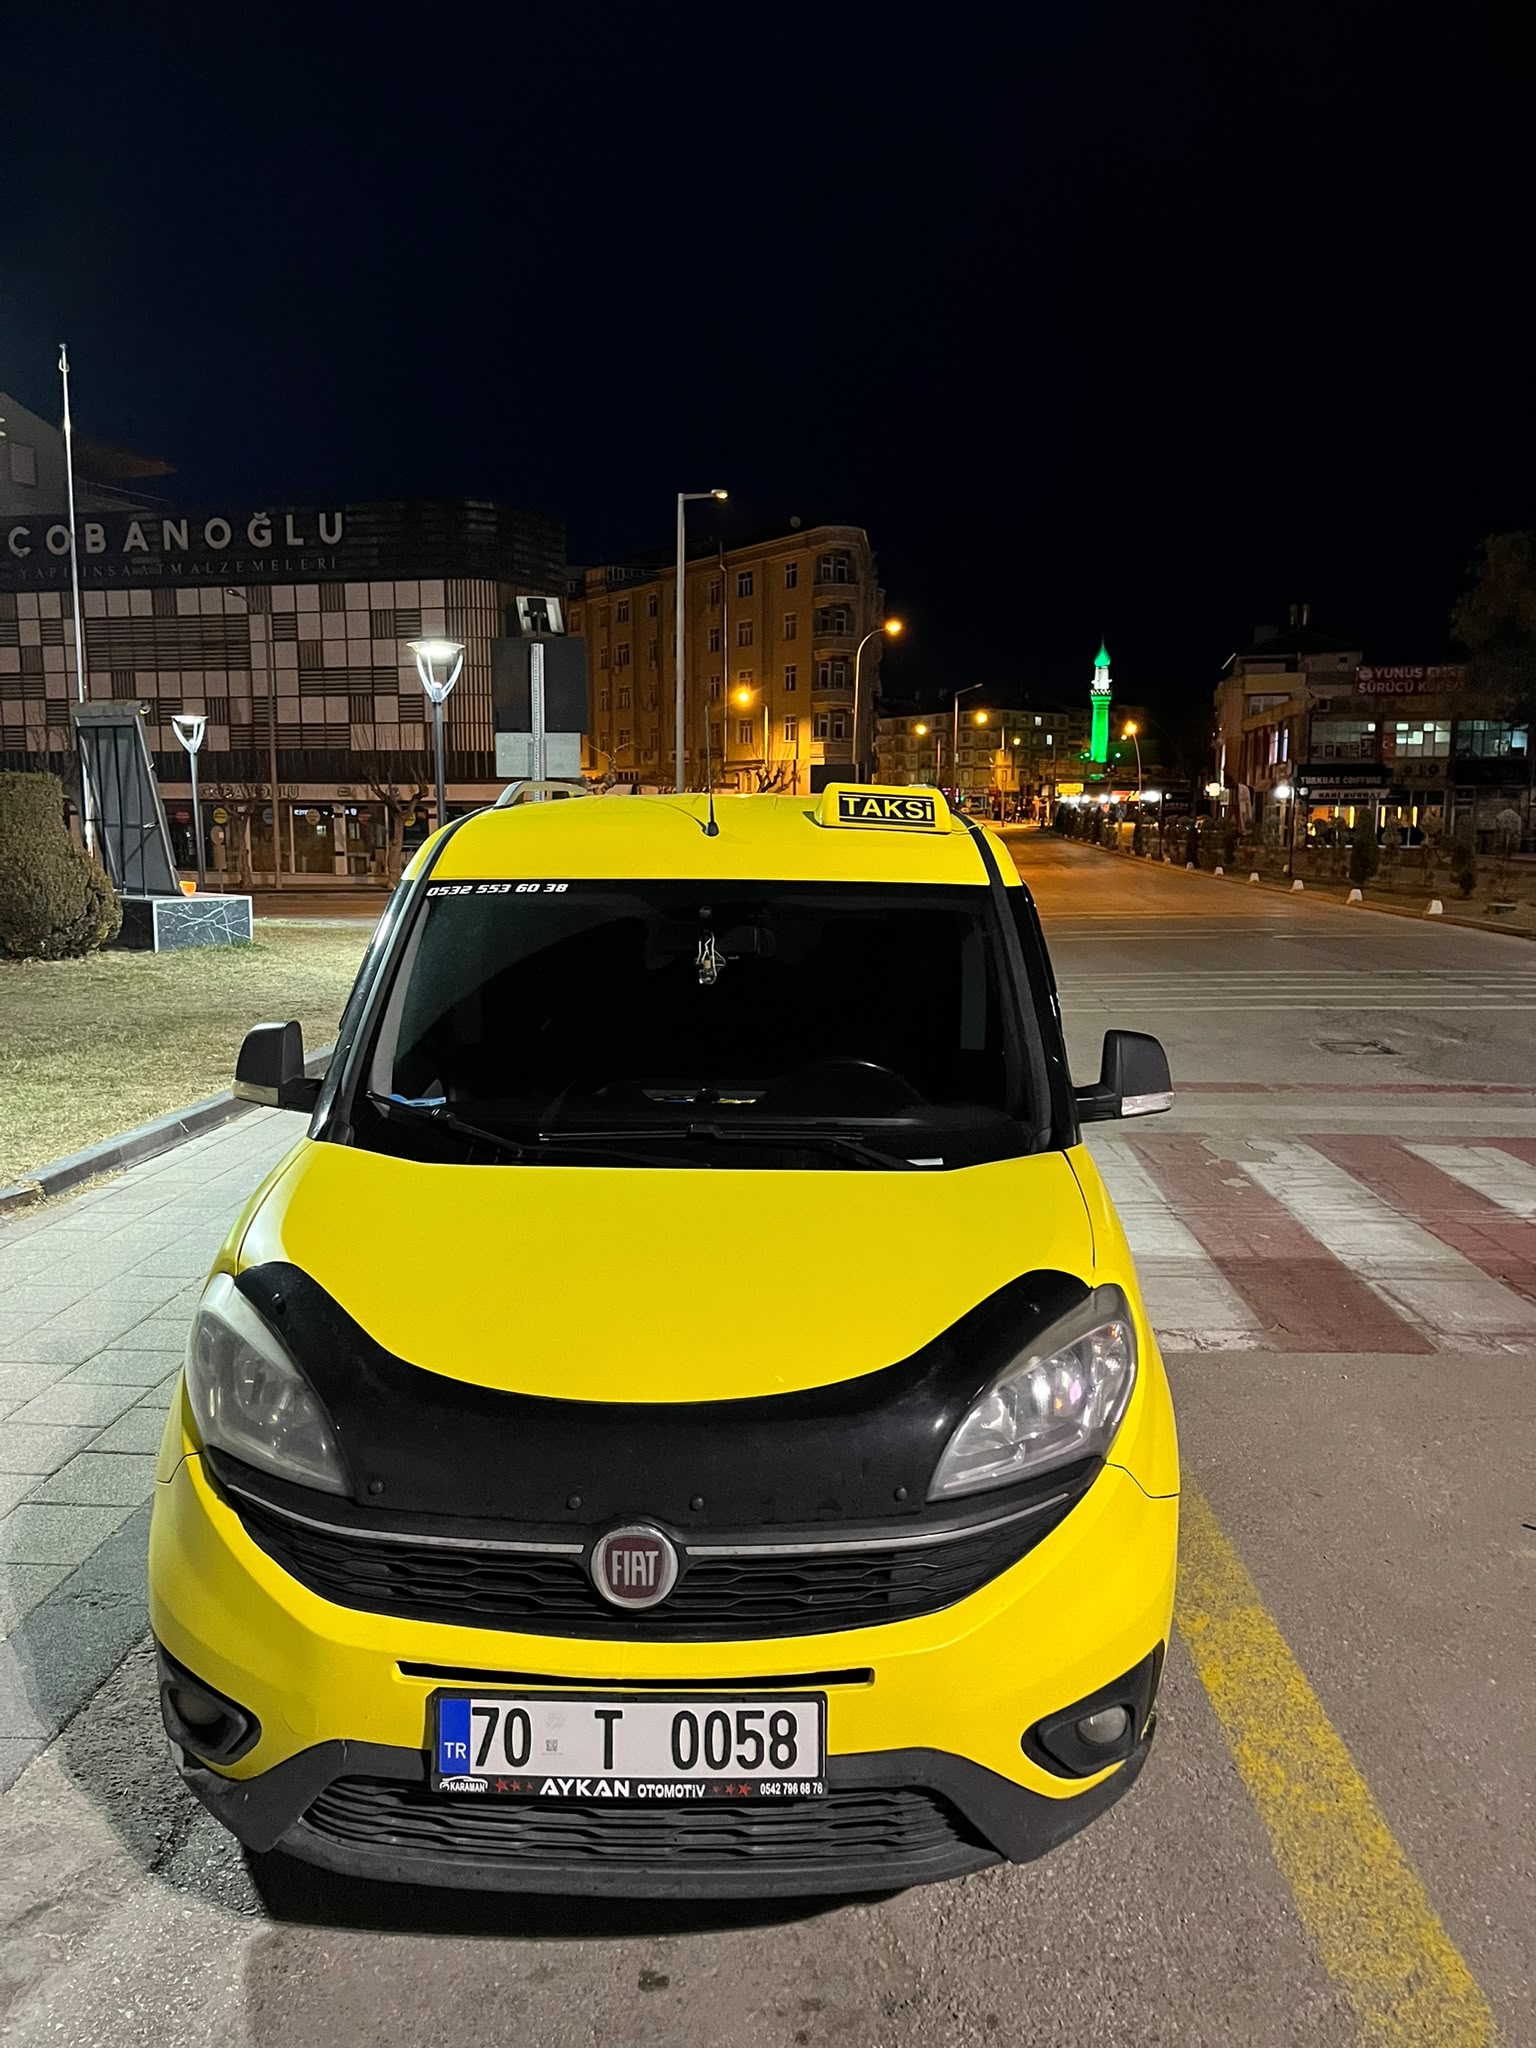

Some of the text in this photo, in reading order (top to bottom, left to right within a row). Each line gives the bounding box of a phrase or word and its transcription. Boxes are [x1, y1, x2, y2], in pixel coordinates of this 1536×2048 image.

[8, 511, 343, 558] ÇOBANOĞLU
[1375, 665, 1465, 679] YUNUS EE
[1358, 680, 1414, 694] SÜRÜCÜ
[425, 883, 569, 897] 0532 553 60 38
[611, 1550, 660, 1587] FIAT
[471, 1706, 798, 1771] 70 T 0058
[443, 1741, 467, 1759] TR
[449, 1781, 485, 1793] KARAMAN
[539, 1777, 630, 1798] AYKAN
[760, 1782, 782, 1795] 0542
